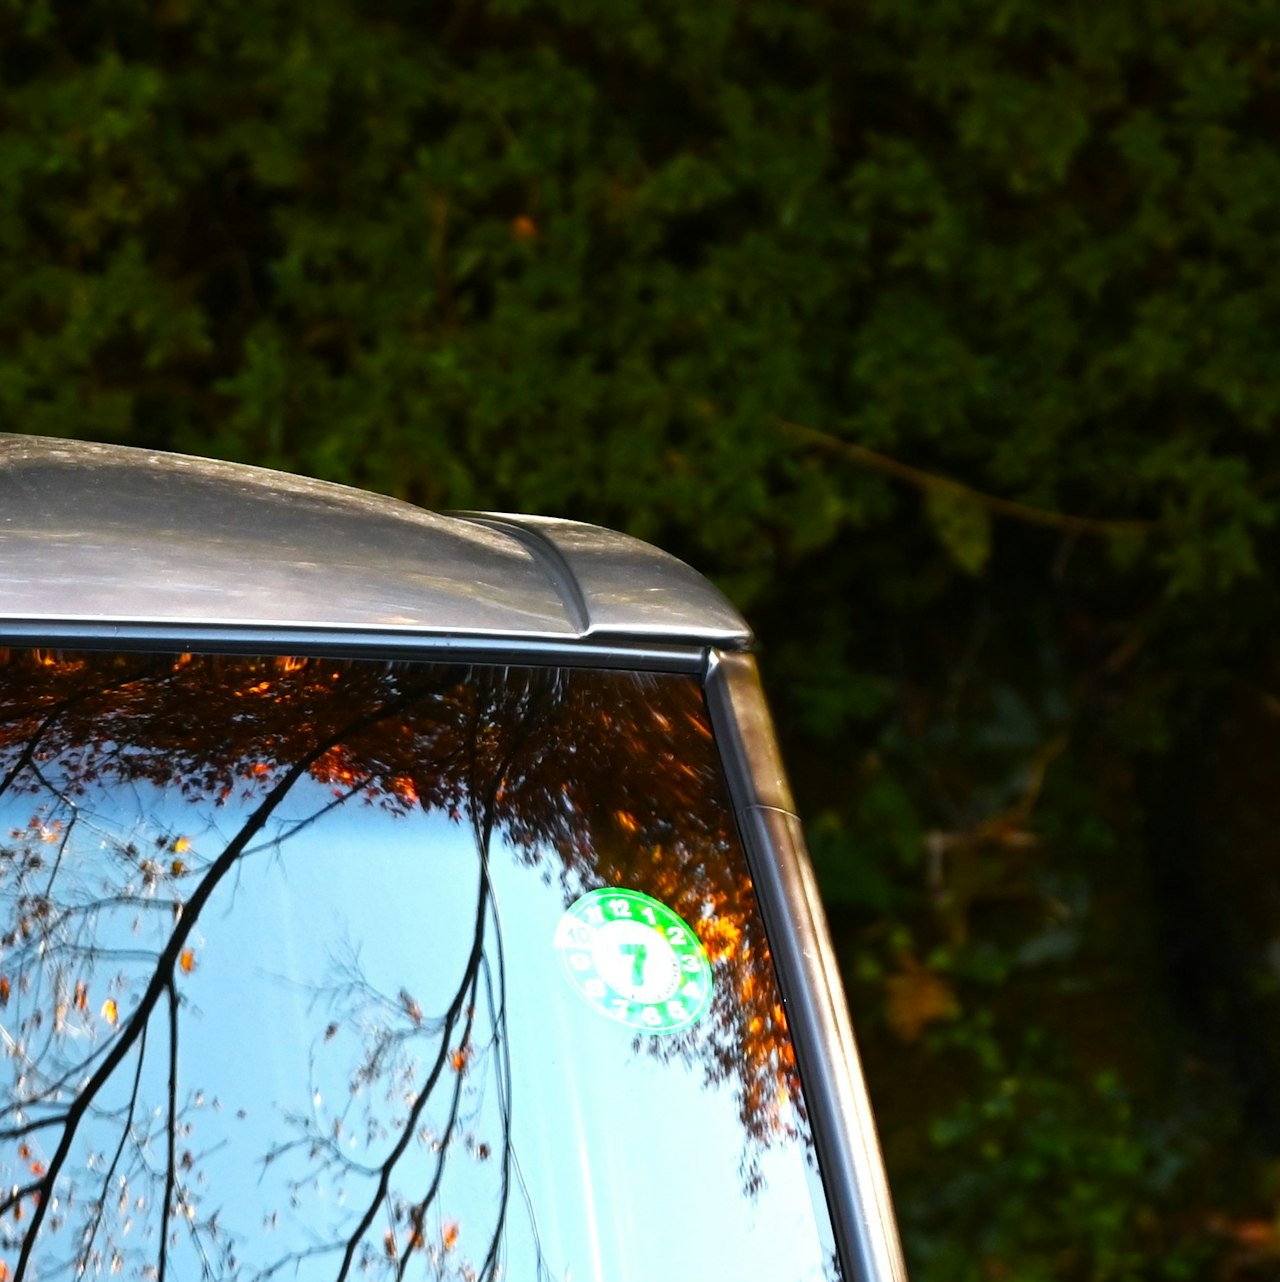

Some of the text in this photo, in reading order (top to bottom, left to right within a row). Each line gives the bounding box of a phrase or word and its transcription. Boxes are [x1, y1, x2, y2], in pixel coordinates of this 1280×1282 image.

[584, 905, 605, 924] 11
[608, 899, 632, 918] 12
[642, 907, 656, 925] 1
[567, 925, 591, 944] 10
[667, 927, 686, 945] 2
[570, 953, 590, 972] 9
[619, 944, 647, 986] 7
[681, 954, 700, 973] 3
[682, 981, 701, 999] 4
[611, 999, 630, 1020] 7
[642, 1006, 662, 1025] 6
[667, 1000, 687, 1020] 5
